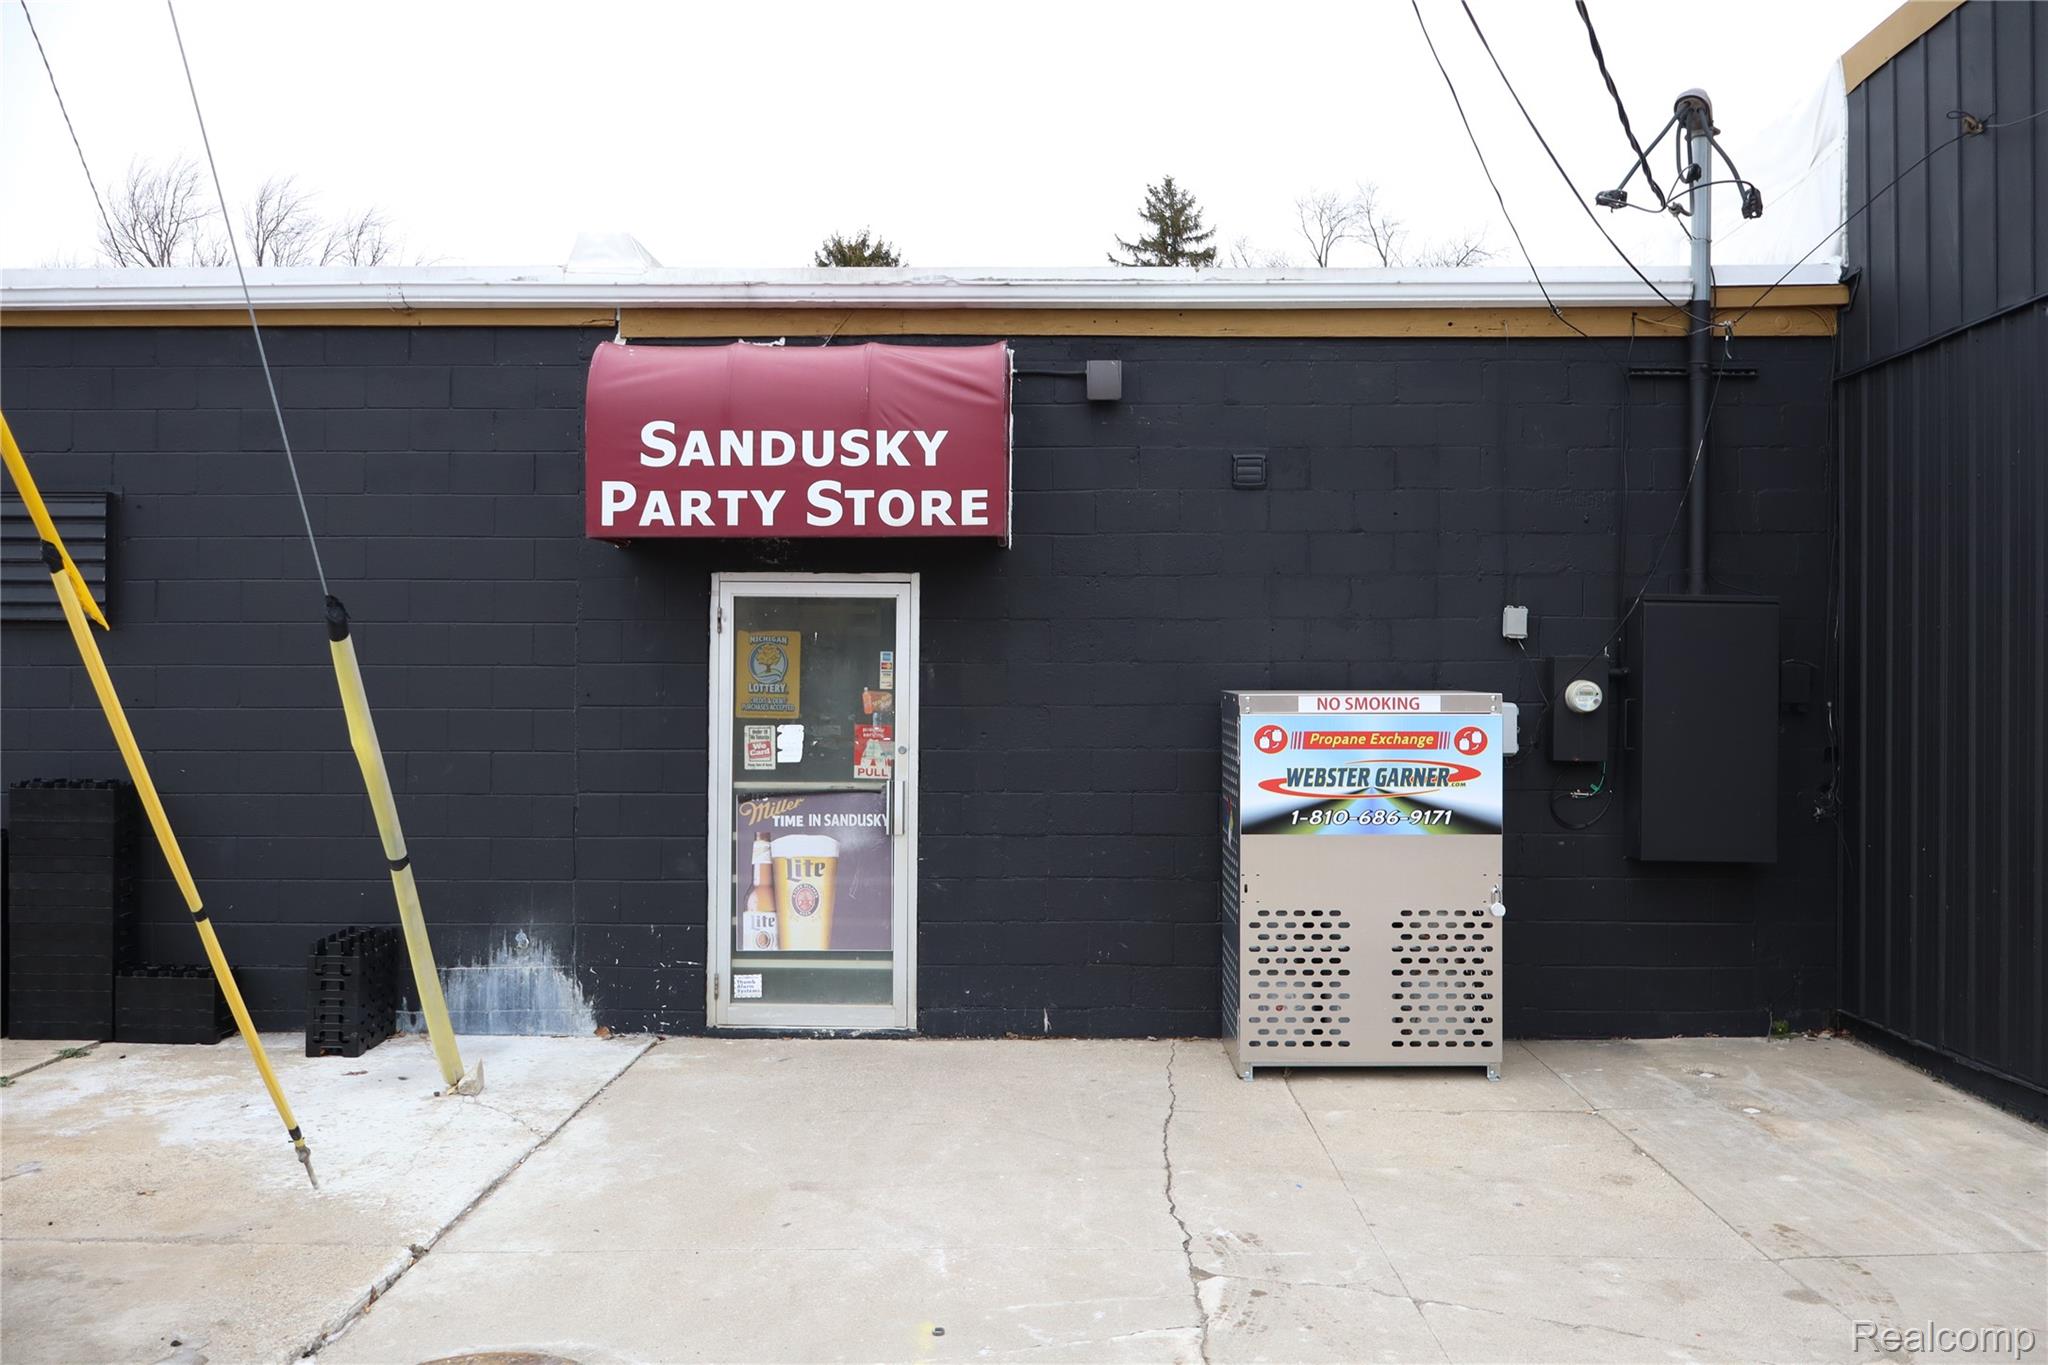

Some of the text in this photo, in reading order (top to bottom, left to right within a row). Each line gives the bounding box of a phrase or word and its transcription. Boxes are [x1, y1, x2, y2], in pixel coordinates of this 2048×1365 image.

[639, 420, 949, 467] SANDUSKY
[601, 479, 989, 527] PARTY STORE
[750, 636, 787, 644] MICHIGAN
[748, 683, 786, 693] LOTTERY
[1317, 697, 1420, 711] NO SMOKING
[1309, 732, 1434, 749] Propane Exchange
[857, 768, 888, 777] PULL
[1287, 767, 1371, 788] WEBSTER
[1375, 767, 1451, 788] GARNER
[739, 798, 805, 826] Miller
[772, 815, 804, 827] TIME
[808, 814, 821, 827] IN
[1291, 809, 1453, 826] 1-810-686-9171
[787, 859, 826, 882] Lite
[751, 915, 776, 930] Lite
